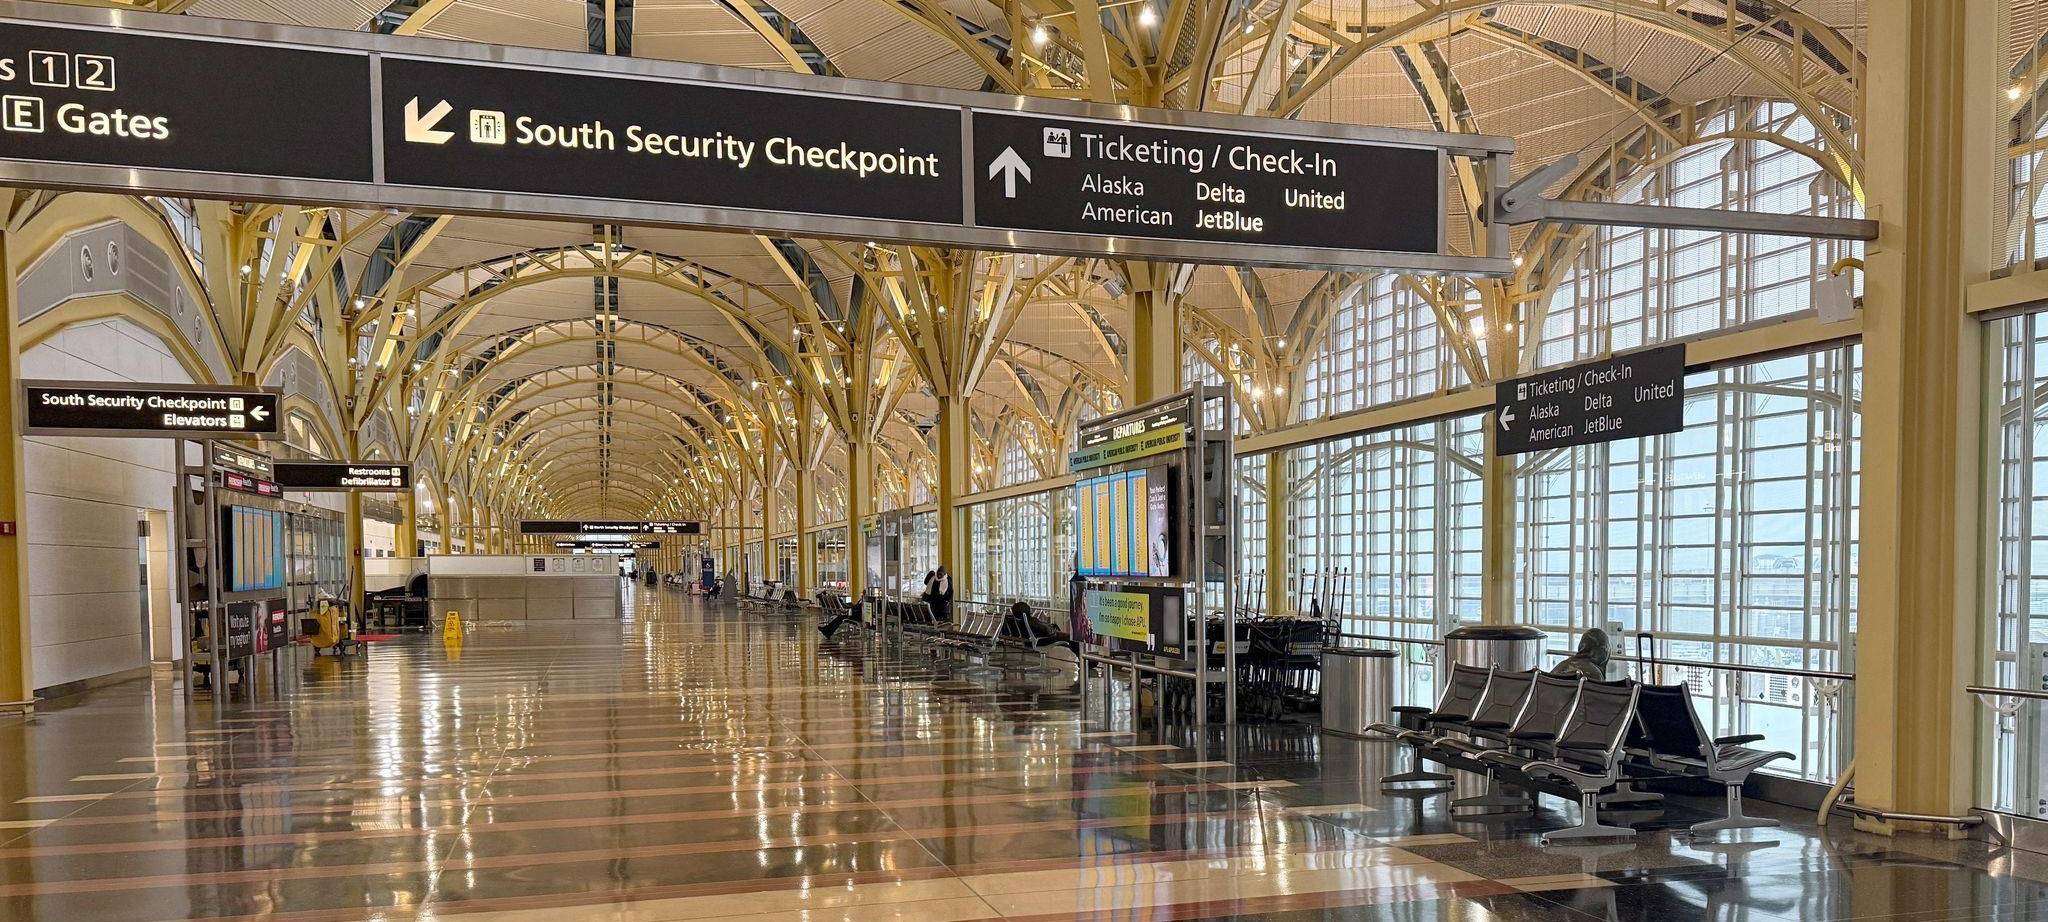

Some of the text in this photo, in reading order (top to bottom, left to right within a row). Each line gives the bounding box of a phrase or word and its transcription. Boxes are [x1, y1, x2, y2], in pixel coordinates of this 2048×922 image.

[57, 102, 170, 140] Gates
[515, 115, 941, 178] South Security Checkpoint
[1080, 133, 1338, 177] Ticketing / Check-In
[1081, 173, 1346, 211] Alaska Delta United
[1081, 201, 1265, 232] American JetBlue
[1529, 363, 1632, 398] Ticketing / Check-In
[41, 393, 227, 412] South Security Checkpoint
[1529, 379, 1675, 422] Alaska Delta United
[163, 413, 228, 427] Elevators
[1113, 420, 1145, 440] DEPARTURES
[1529, 415, 1623, 443] American JetBlue
[341, 477, 391, 486] Defibrillator
[348, 467, 391, 476] Restrooms
[1118, 597, 1128, 611] good
